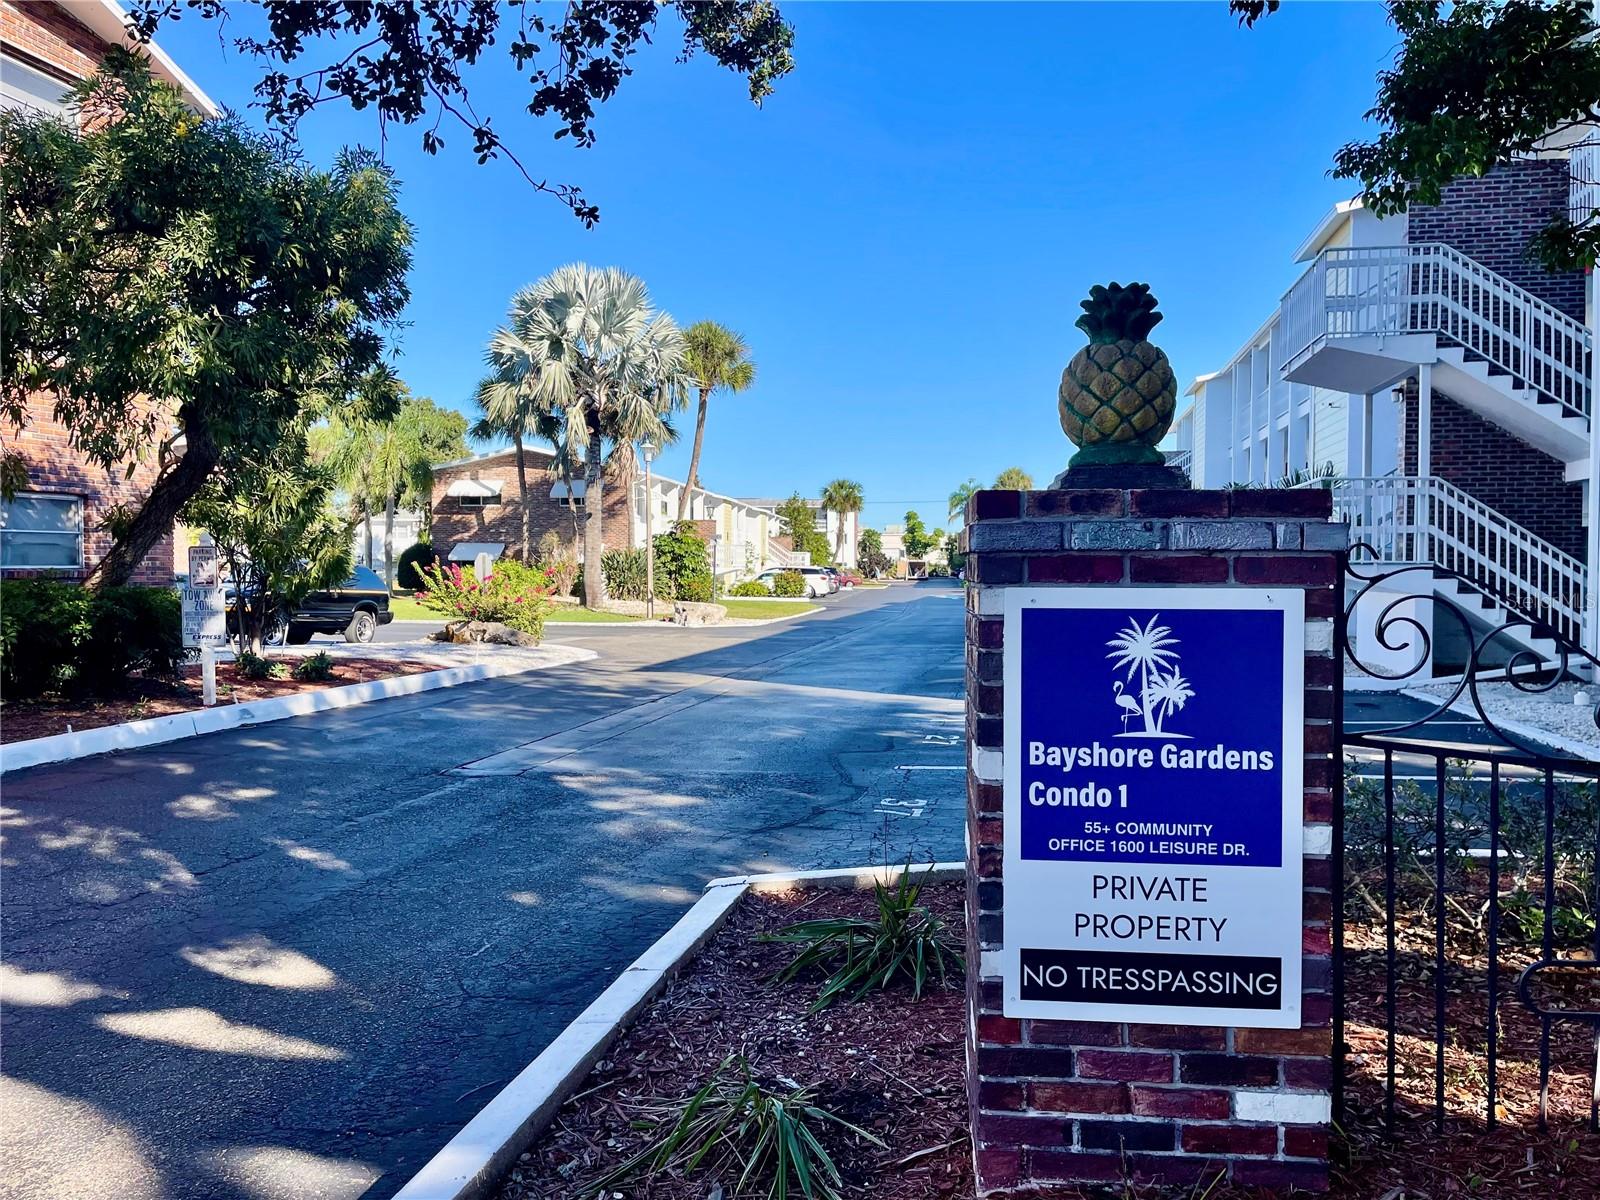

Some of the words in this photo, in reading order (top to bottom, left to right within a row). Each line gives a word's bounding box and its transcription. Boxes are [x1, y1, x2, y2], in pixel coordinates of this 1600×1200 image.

[184, 590, 201, 600] TOW
[194, 601, 214, 611] ZONE
[1029, 742, 1154, 773] Bayshore
[1160, 744, 1274, 771] Gardens
[1029, 781, 1112, 808] Condo
[1118, 784, 1128, 808] 1
[1084, 821, 1111, 834] 55+
[1115, 822, 1213, 837] COMMUNITY
[1048, 838, 1105, 852] OFFICE
[1110, 840, 1145, 853] 1600
[1149, 841, 1218, 856] LEISURE
[1222, 843, 1250, 857] DR.
[1092, 875, 1208, 902] PRIVATE
[1074, 913, 1228, 942] PROPERTY
[1023, 964, 1068, 988] NO
[1076, 966, 1278, 996] TRESSPASSING
